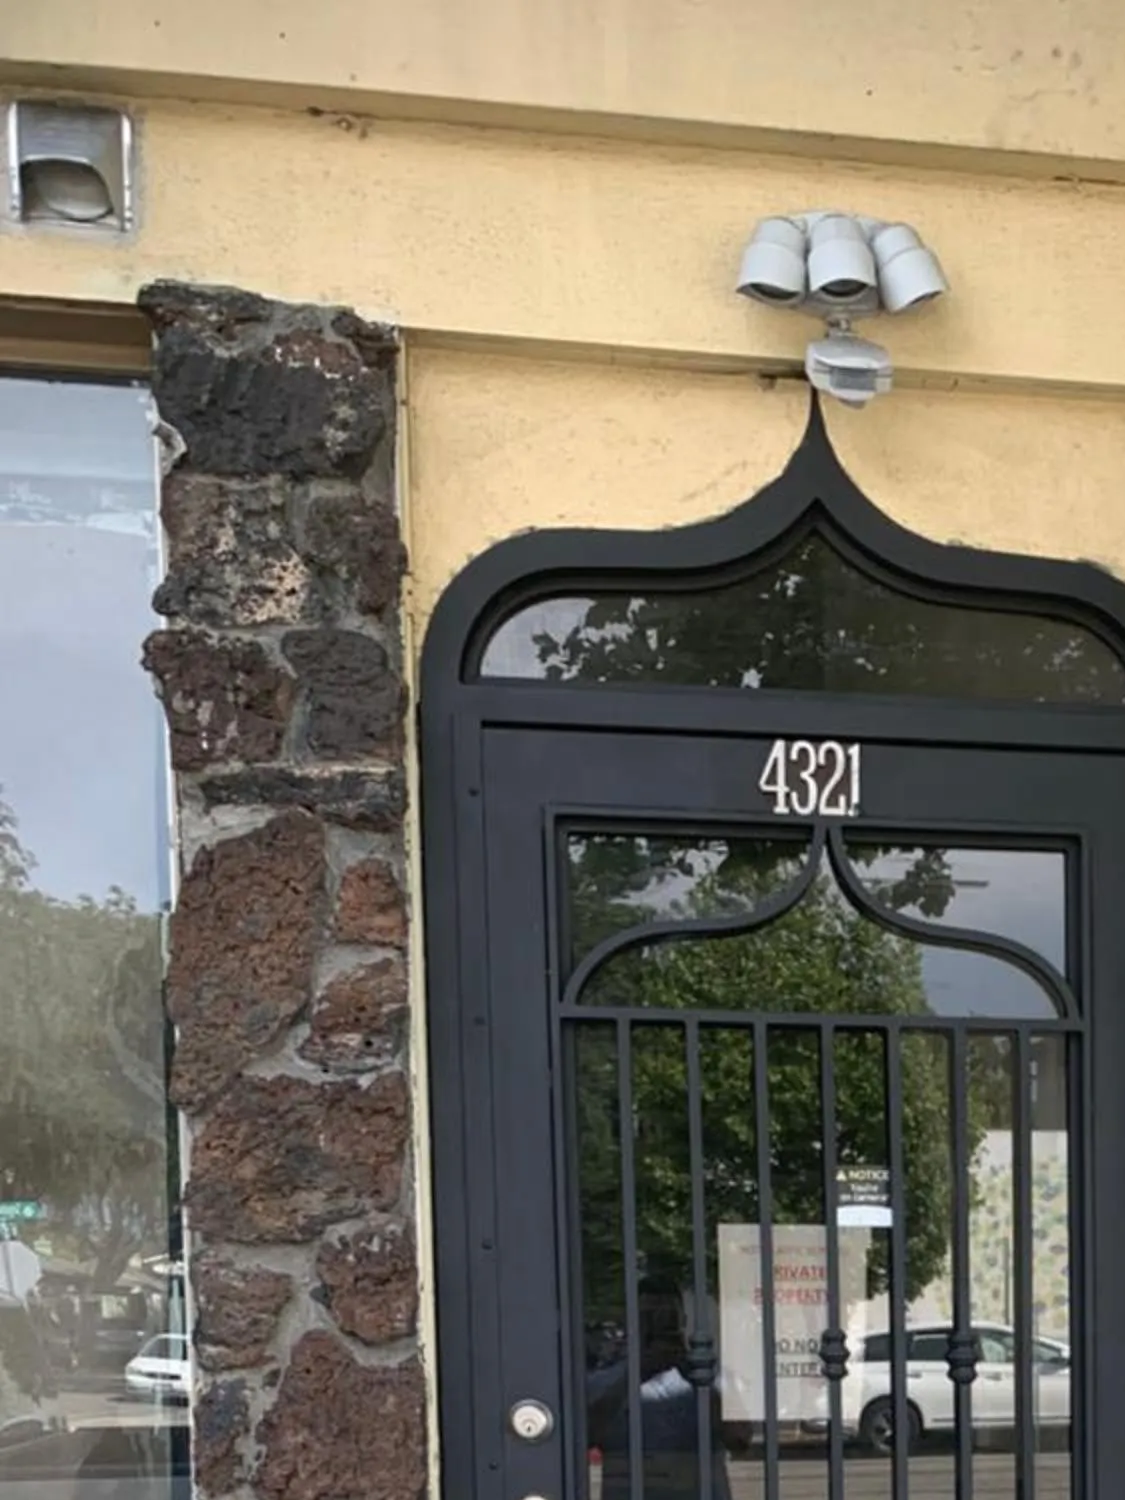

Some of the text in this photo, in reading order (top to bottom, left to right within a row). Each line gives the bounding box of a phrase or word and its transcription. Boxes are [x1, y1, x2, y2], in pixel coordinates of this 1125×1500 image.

[759, 739, 860, 816] 4321
[848, 1169, 890, 1180] NOTICE
[772, 1264, 828, 1280] RIVATE
[753, 1285, 830, 1304] POPERT
[779, 1361, 821, 1378] NTER
